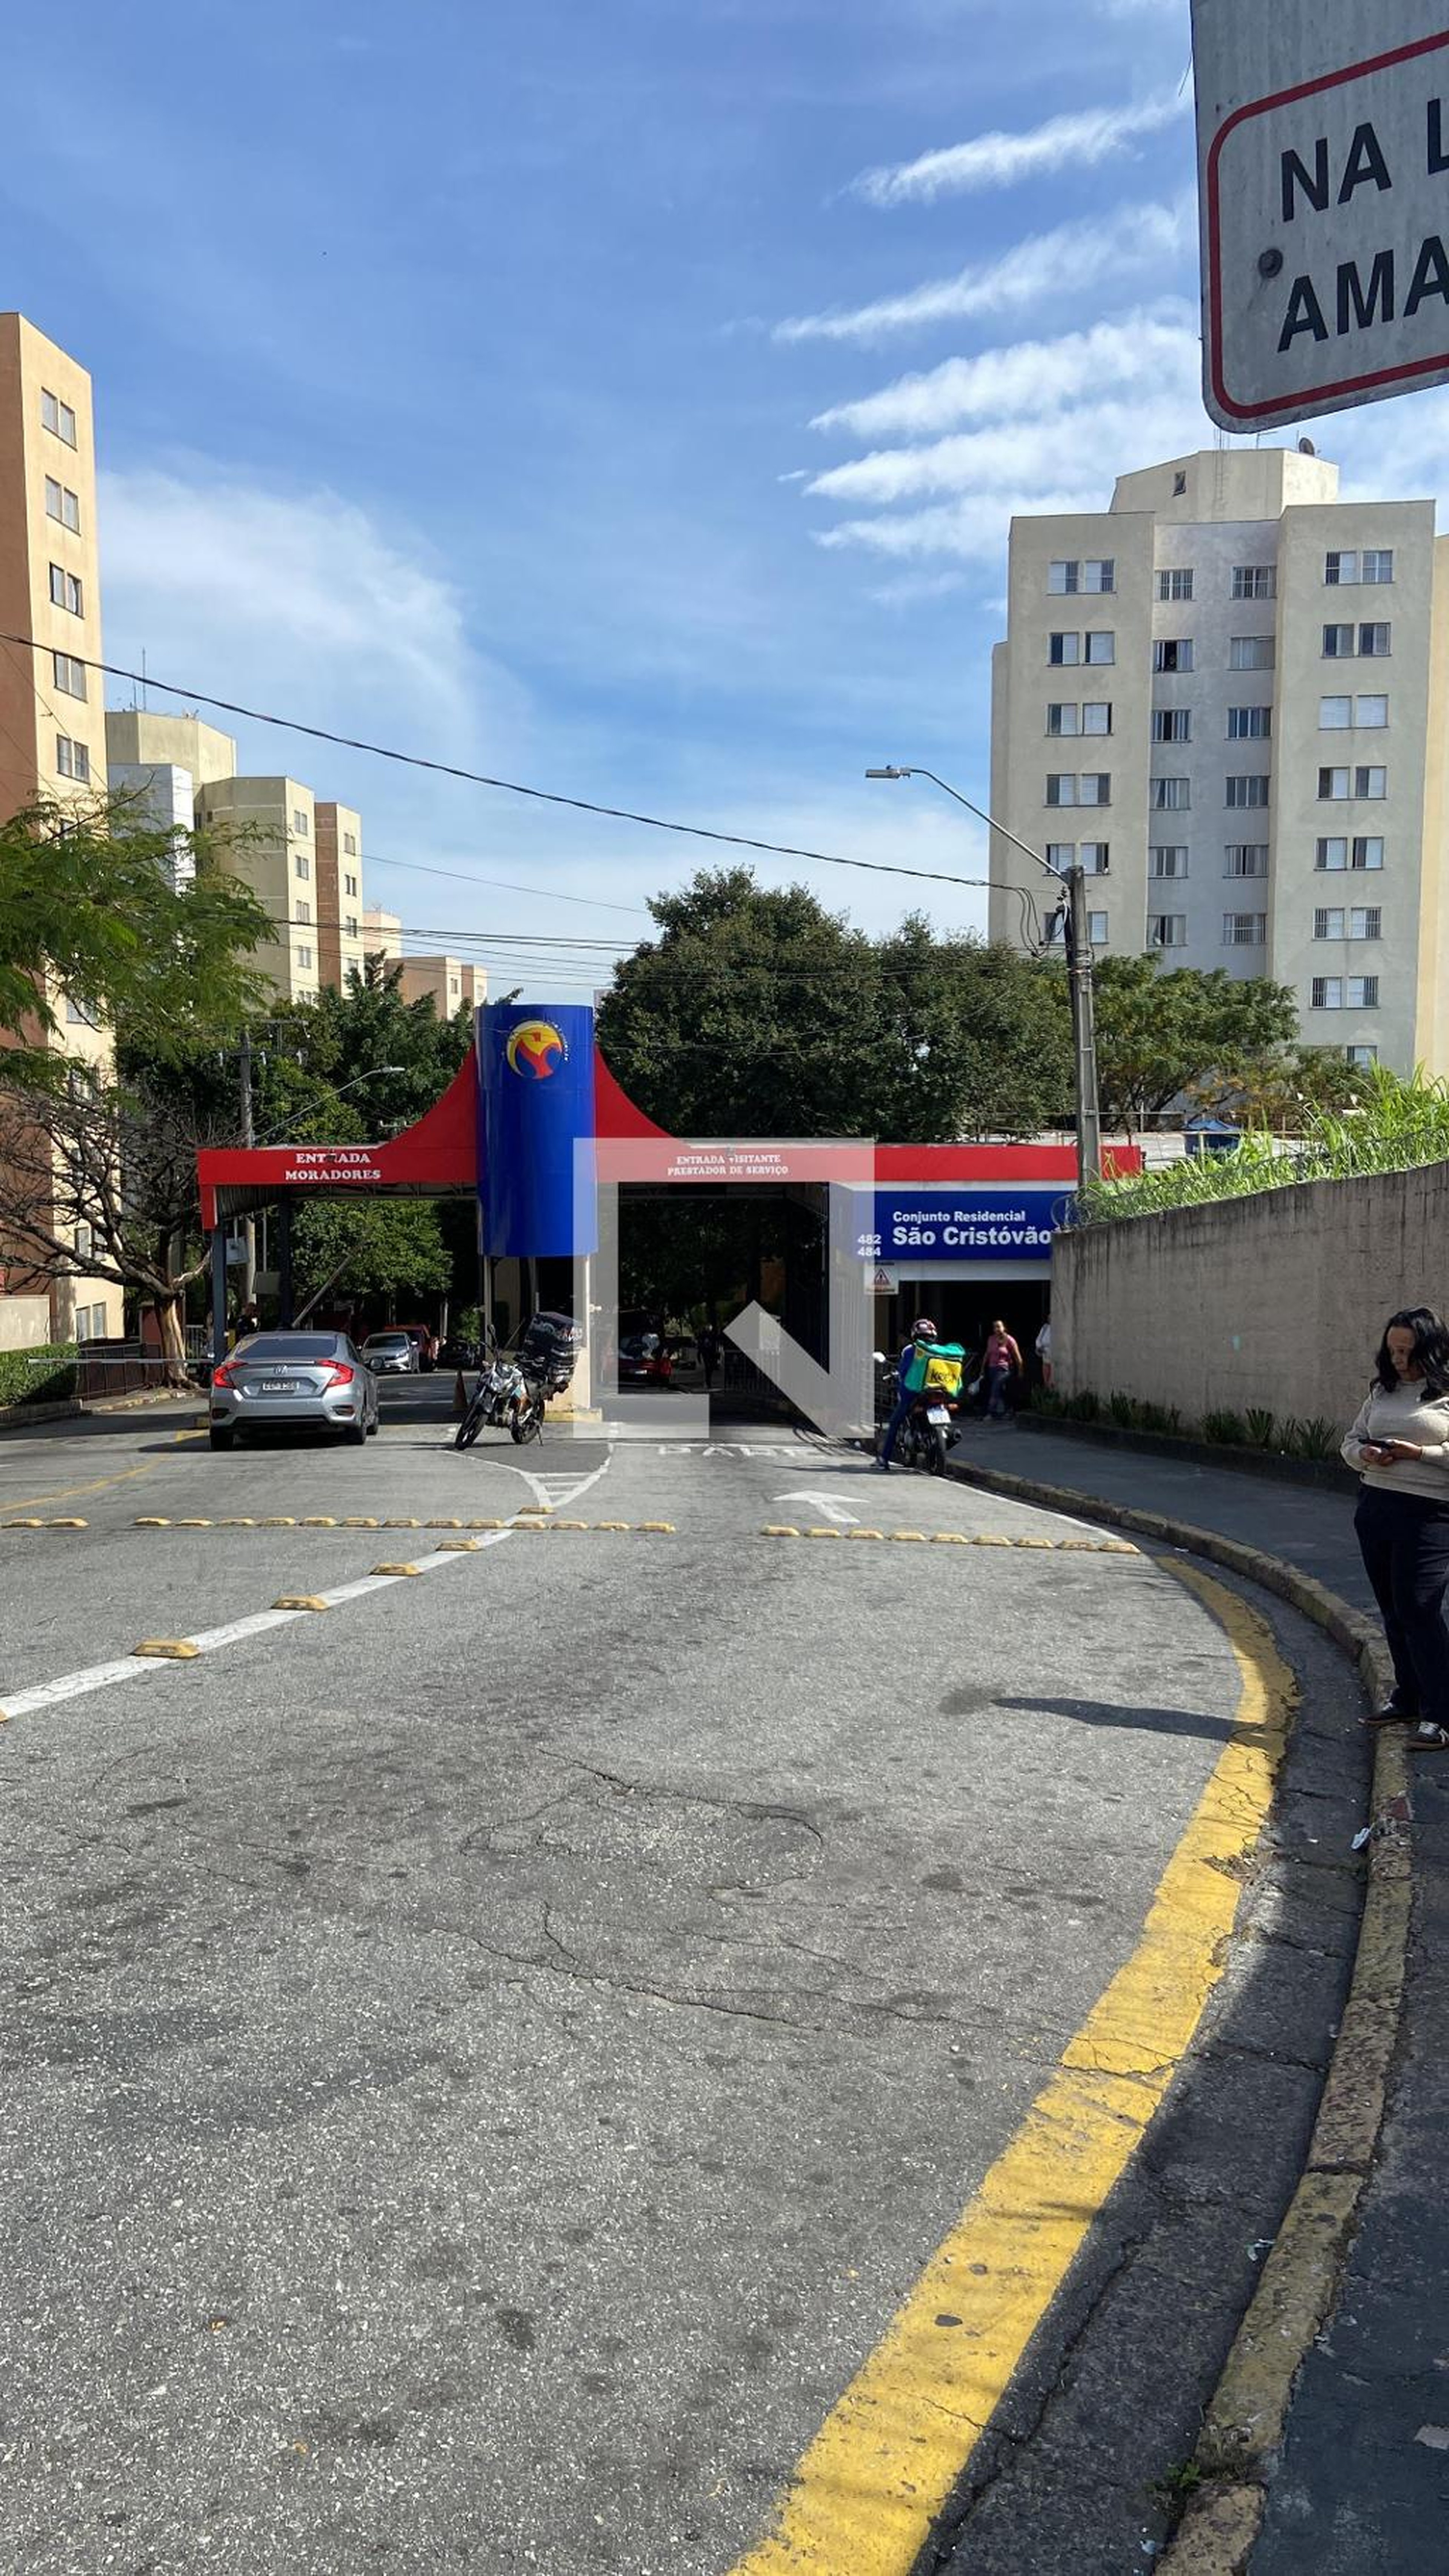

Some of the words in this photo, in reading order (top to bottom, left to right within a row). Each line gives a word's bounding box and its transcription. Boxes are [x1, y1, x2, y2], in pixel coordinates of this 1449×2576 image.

[1281, 122, 1392, 223] NA
[1277, 235, 1449, 354] AMA
[677, 1156, 725, 1164] ENTRADA
[285, 1170, 381, 1180] MORADORES
[668, 1167, 726, 1176] PRESTADOR
[730, 1166, 743, 1175] DE
[746, 1166, 789, 1176] SERVIÇO
[893, 1211, 951, 1224] Conjunto
[954, 1210, 1026, 1222] Residencial
[858, 1234, 881, 1244] 482
[892, 1226, 936, 1245] São
[943, 1226, 1052, 1245] Cristóvão
[858, 1246, 881, 1256] 484
